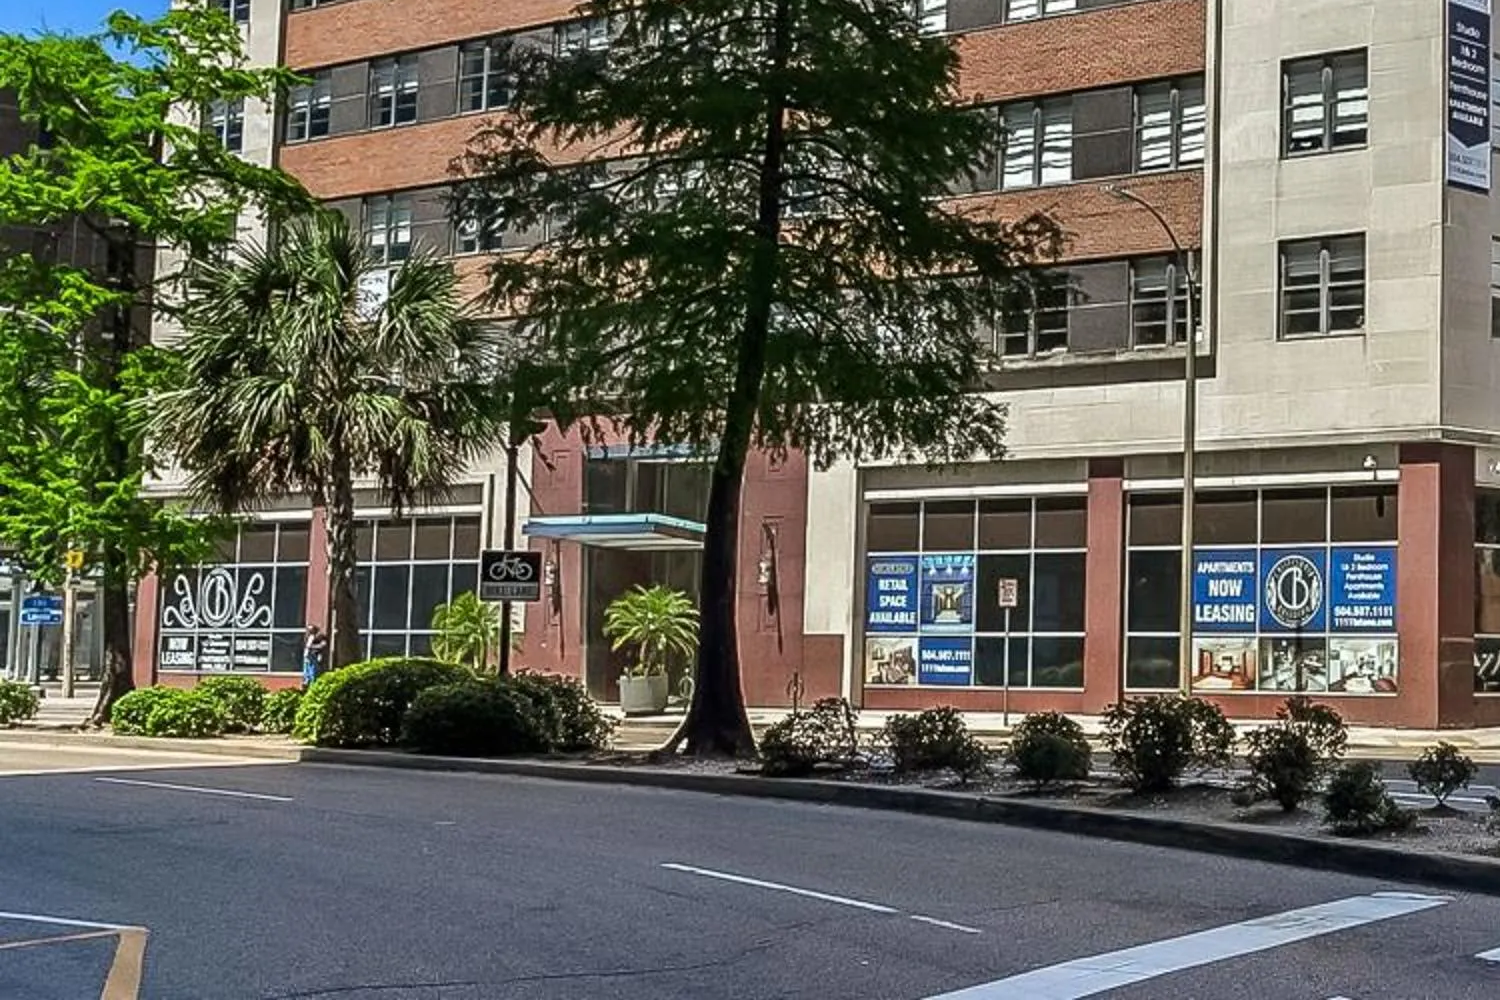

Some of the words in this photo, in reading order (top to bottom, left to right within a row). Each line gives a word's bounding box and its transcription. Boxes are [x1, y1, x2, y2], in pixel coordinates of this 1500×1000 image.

[1197, 561, 1255, 574] APARTMENTS
[877, 579, 909, 591] RETAIL
[1208, 579, 1243, 598] NOW
[879, 595, 908, 608] SPACE
[869, 611, 916, 624] AVAILABLE
[1195, 603, 1255, 623] LEASING
[161, 651, 194, 665] LEASING
